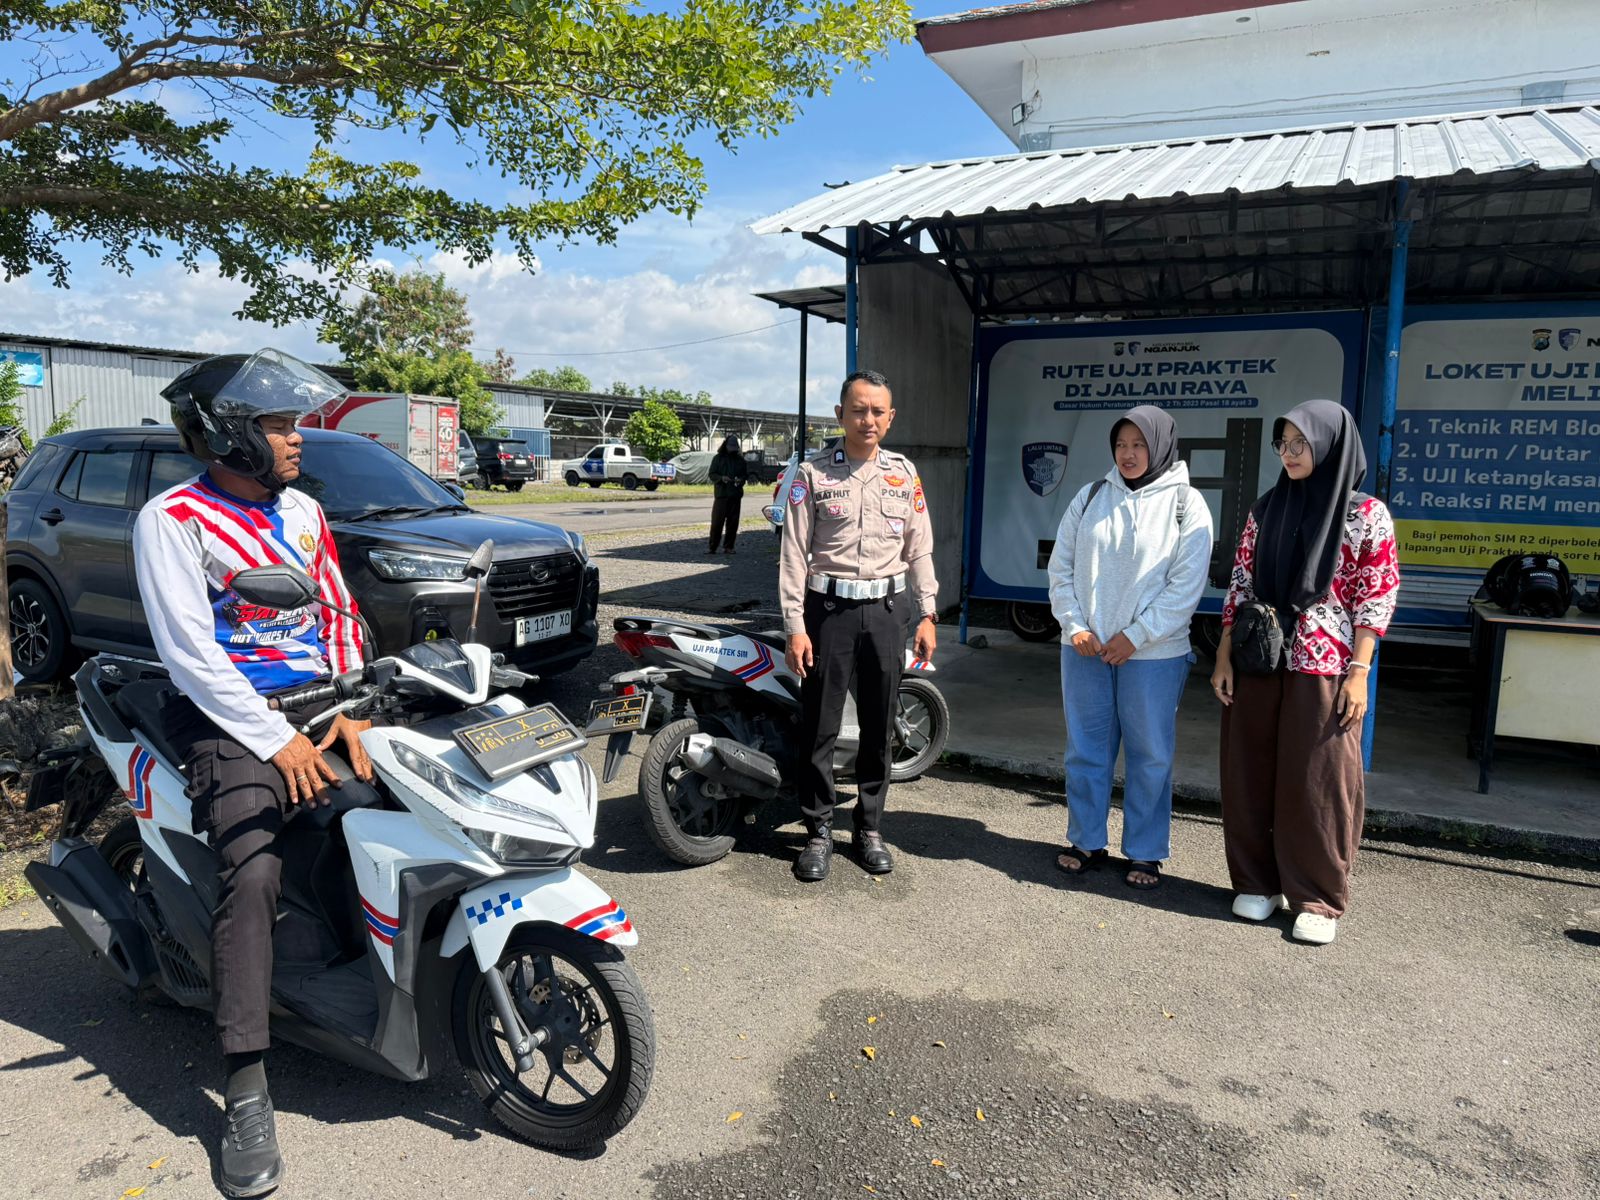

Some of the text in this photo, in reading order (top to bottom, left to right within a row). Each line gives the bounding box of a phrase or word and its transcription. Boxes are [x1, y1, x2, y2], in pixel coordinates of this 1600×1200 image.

[1144, 345, 1200, 353] NGANJUK
[1042, 359, 1277, 379] RUTE UJI PRAKTEK
[1425, 363, 1525, 380] LOKET
[1530, 362, 1588, 379] UJI
[1065, 380, 1248, 397] DI JALAN RAYA
[1401, 418, 1419, 434] 1.
[1428, 418, 1502, 434] Teknik
[1510, 419, 1558, 435] REM
[1397, 443, 1417, 458] 2.
[1425, 443, 1439, 458] U
[1447, 444, 1498, 459] Turn
[1525, 445, 1591, 461] Putar
[1395, 467, 1414, 482] 3.
[1423, 468, 1457, 483] UJI
[881, 488, 910, 500] POLRI
[1391, 492, 1412, 506] 4.
[1420, 492, 1491, 509] Reaksi
[1499, 495, 1546, 511] REM
[1412, 530, 1437, 541] Bagi
[1439, 533, 1491, 544] pemohon
[1494, 534, 1516, 544] SIM
[1519, 535, 1535, 544] R2
[1404, 543, 1456, 555] lapangan
[1459, 545, 1476, 556] Uji
[1479, 547, 1527, 556] Praktek
[1563, 552, 1590, 562] sore
[519, 620, 530, 636] AG
[534, 616, 555, 632] 1107
[229, 634, 254, 643] HUT
[255, 630, 282, 643] KORPS
[692, 644, 748, 658] UJI PRAKTEK SIM
